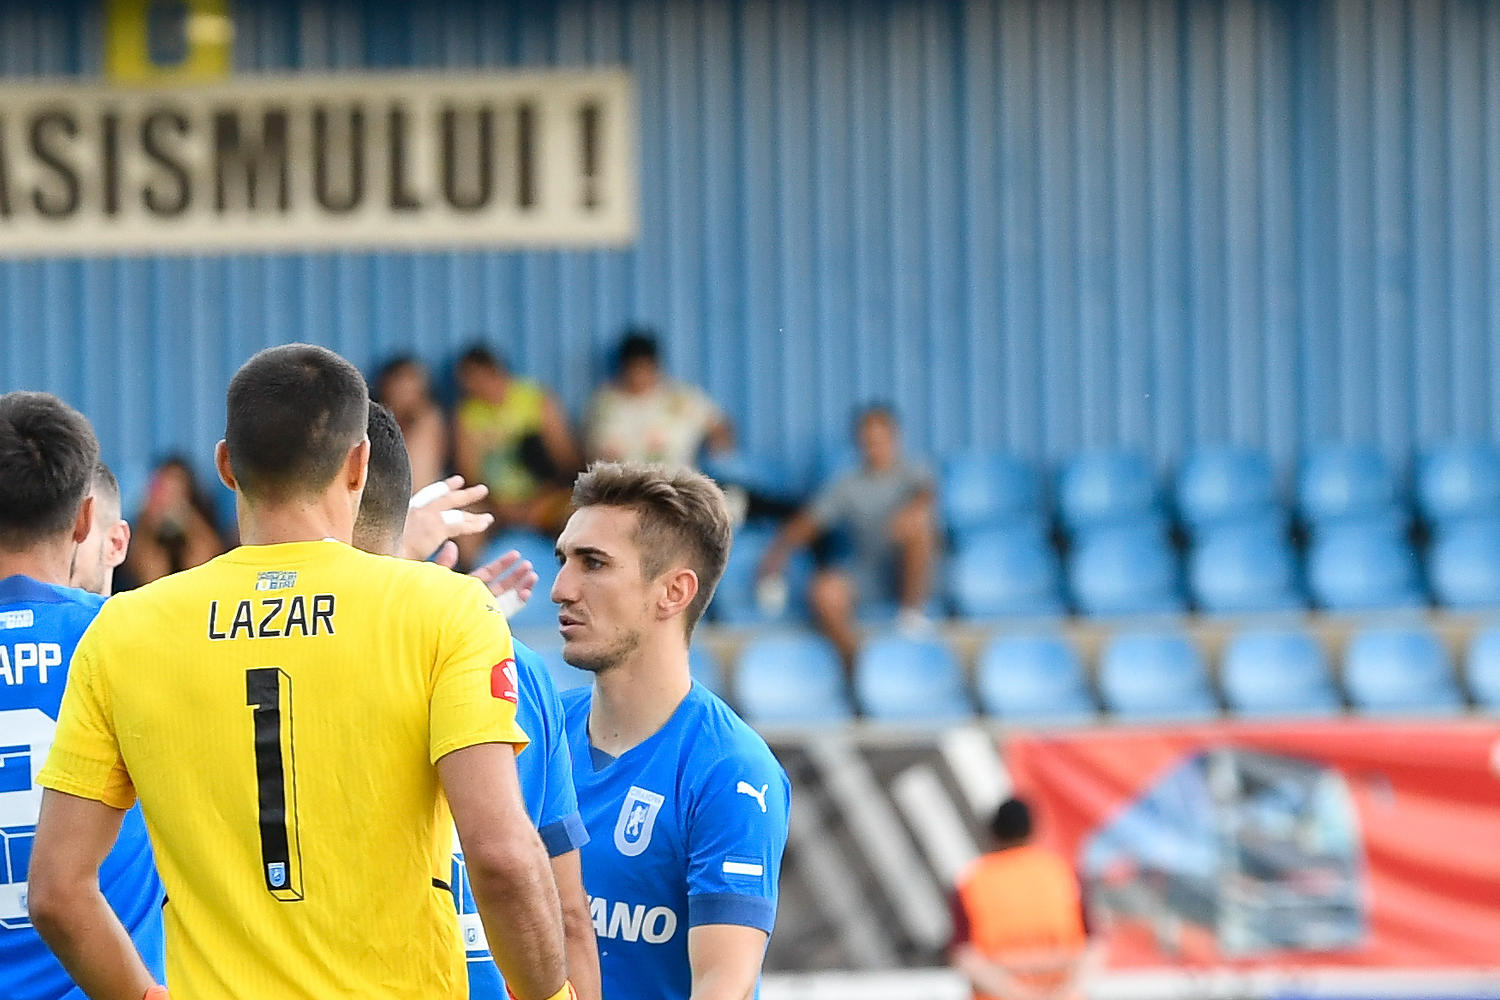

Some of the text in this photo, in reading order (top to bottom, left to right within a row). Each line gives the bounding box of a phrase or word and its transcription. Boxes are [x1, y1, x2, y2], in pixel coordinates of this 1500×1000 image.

[208, 594, 336, 640] LAZAR
[246, 668, 304, 901] 1
[587, 895, 677, 944] ANO
